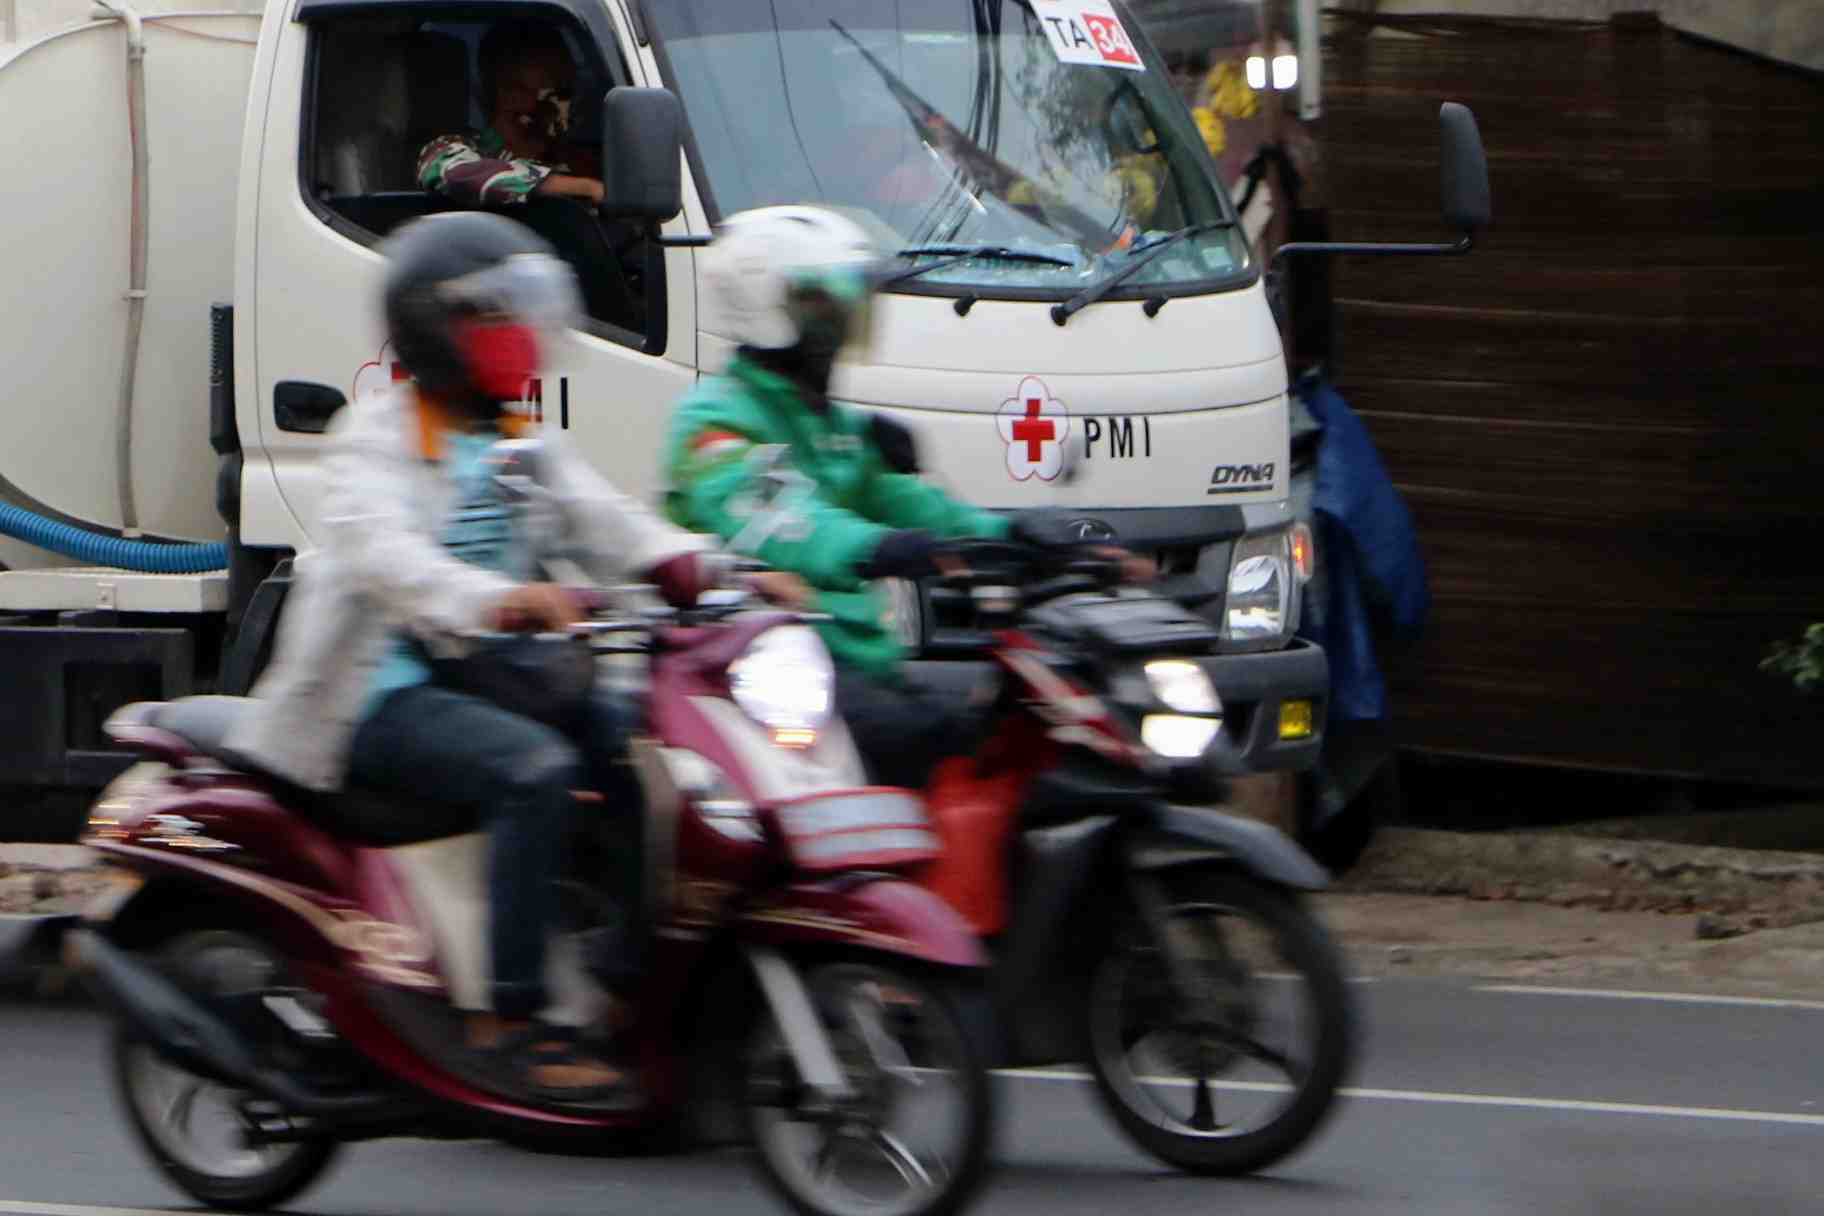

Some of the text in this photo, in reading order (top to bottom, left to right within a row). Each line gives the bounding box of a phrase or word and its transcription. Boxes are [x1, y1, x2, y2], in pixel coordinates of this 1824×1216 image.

[1044, 16, 1094, 52] TA
[1083, 416, 1153, 459] PMI
[1211, 462, 1275, 485] DYNA
